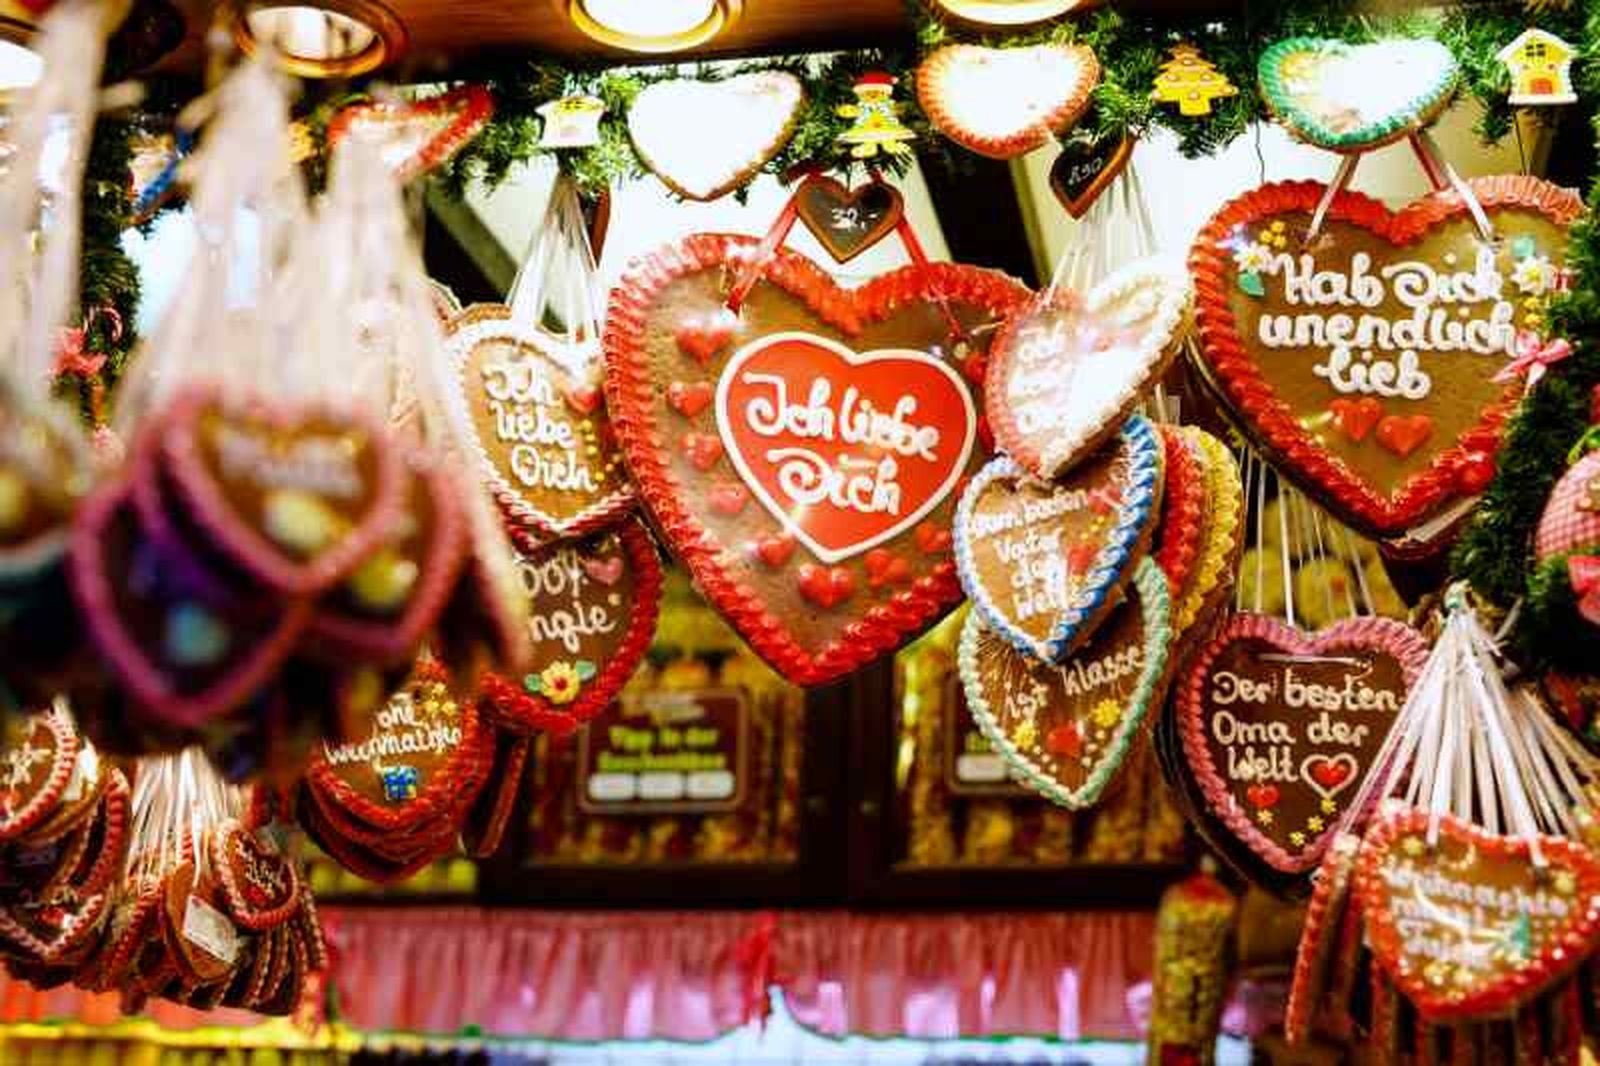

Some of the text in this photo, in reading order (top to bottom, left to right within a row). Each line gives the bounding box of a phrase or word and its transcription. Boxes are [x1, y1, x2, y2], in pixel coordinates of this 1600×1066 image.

[1266, 242, 1504, 308] Hab Dich
[1258, 300, 1522, 358] unendlich
[480, 363, 562, 406] Ich
[489, 399, 577, 449] liebe
[742, 370, 941, 462] Ich liebe
[510, 444, 599, 493] Dich
[766, 446, 900, 516] Dich
[529, 601, 616, 654] ngle
[1212, 667, 1402, 712] Der besten
[1211, 710, 1371, 747] Oma der
[1228, 746, 1300, 782] Welt
